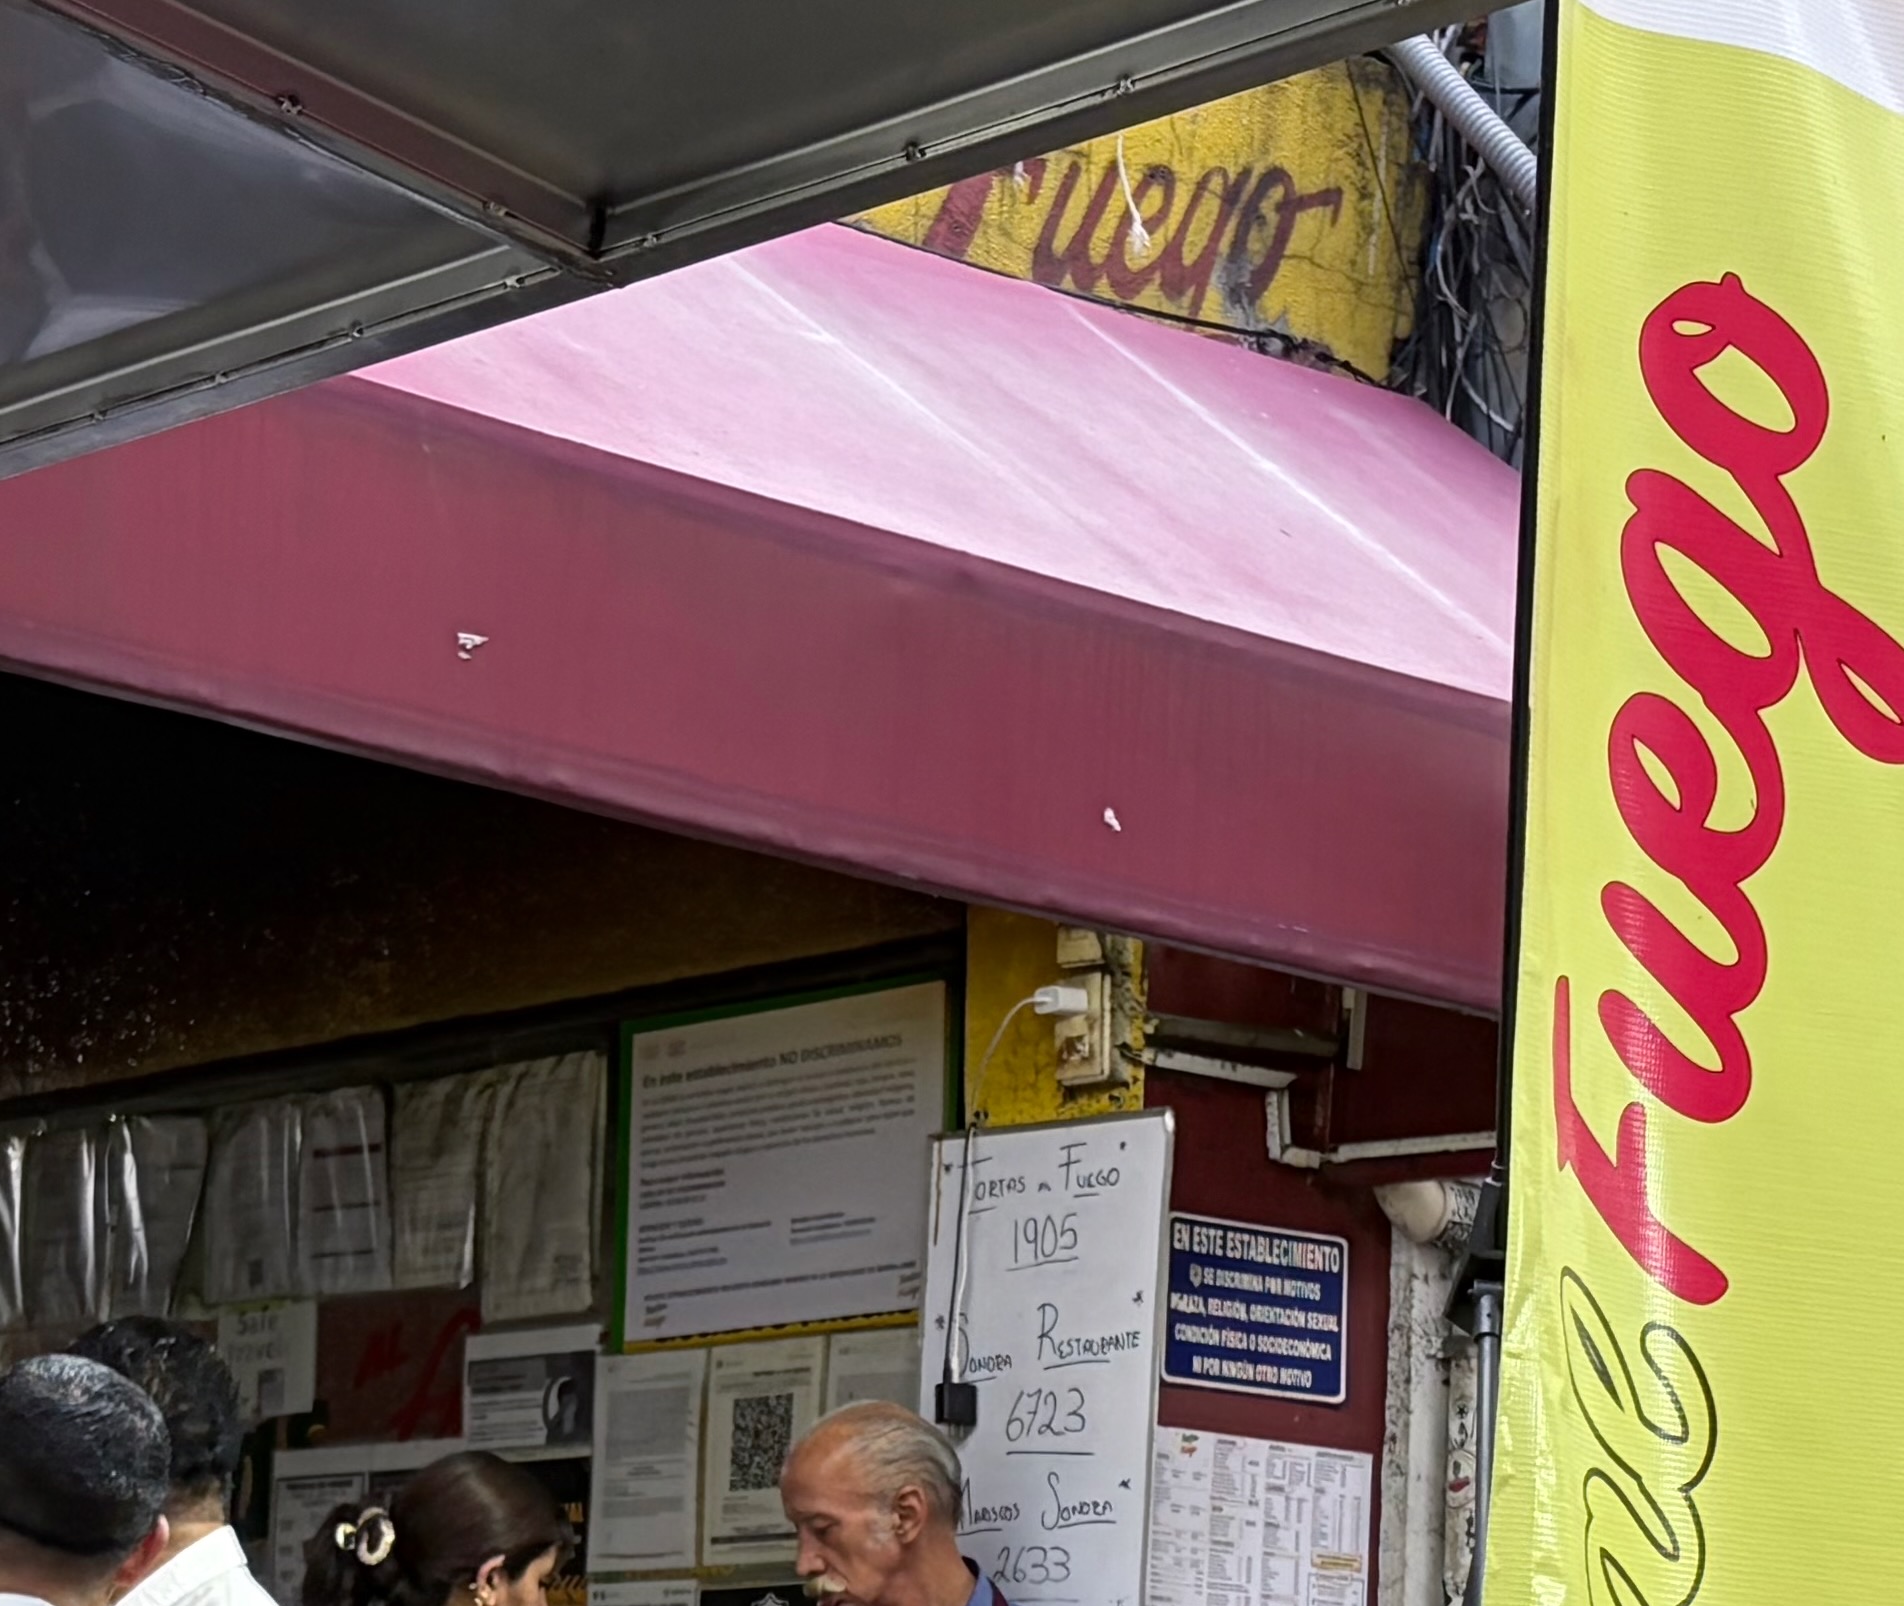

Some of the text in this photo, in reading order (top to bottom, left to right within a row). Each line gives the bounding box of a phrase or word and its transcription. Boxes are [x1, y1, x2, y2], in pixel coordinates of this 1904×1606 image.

[1057, 1141, 1122, 1192] FUEGO
[1012, 1211, 1080, 1265] 1905
[1172, 1221, 1341, 1274] EN ESTE ESTABLECIMIENTO
[1004, 1386, 1087, 1443] 6723
[992, 1545, 1071, 1585] 2633
